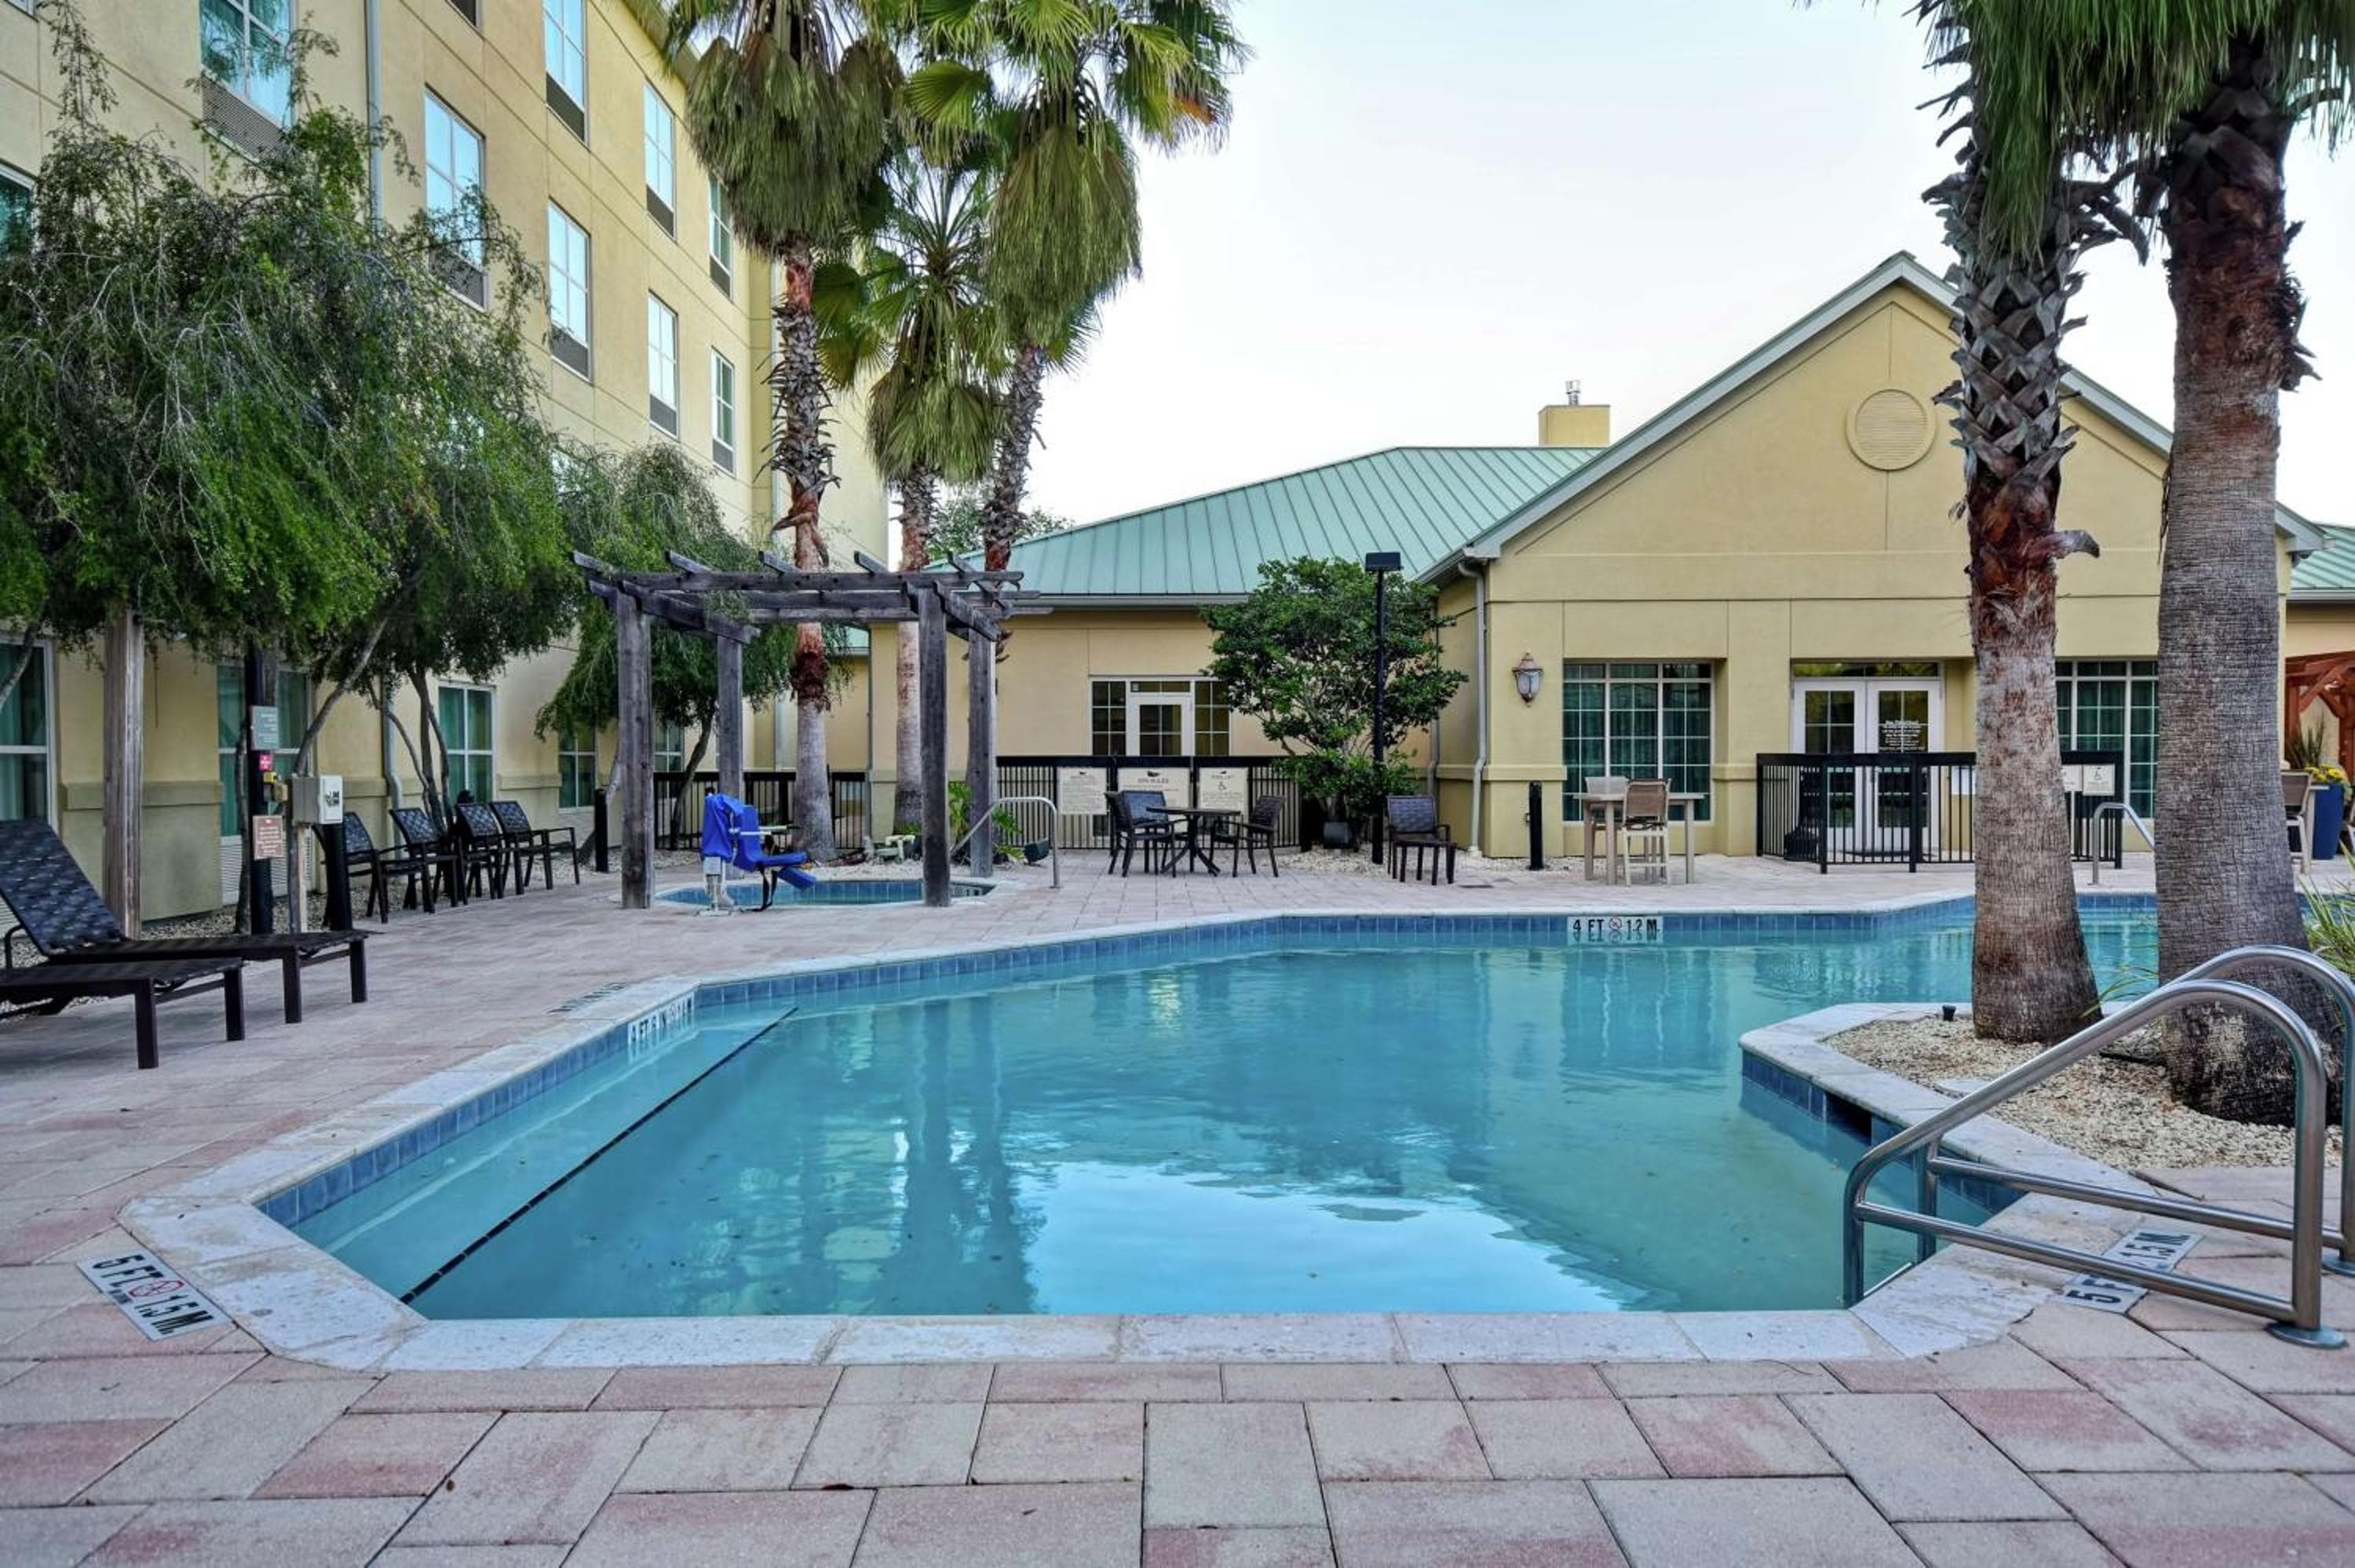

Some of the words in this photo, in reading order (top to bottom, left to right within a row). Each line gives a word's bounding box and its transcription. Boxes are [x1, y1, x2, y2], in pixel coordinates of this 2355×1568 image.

[1572, 919, 1581, 931] 4
[1587, 919, 1605, 932] FT
[92, 1254, 145, 1269] 5
[2082, 1273, 2134, 1293] F
[2065, 1289, 2122, 1304] 5
